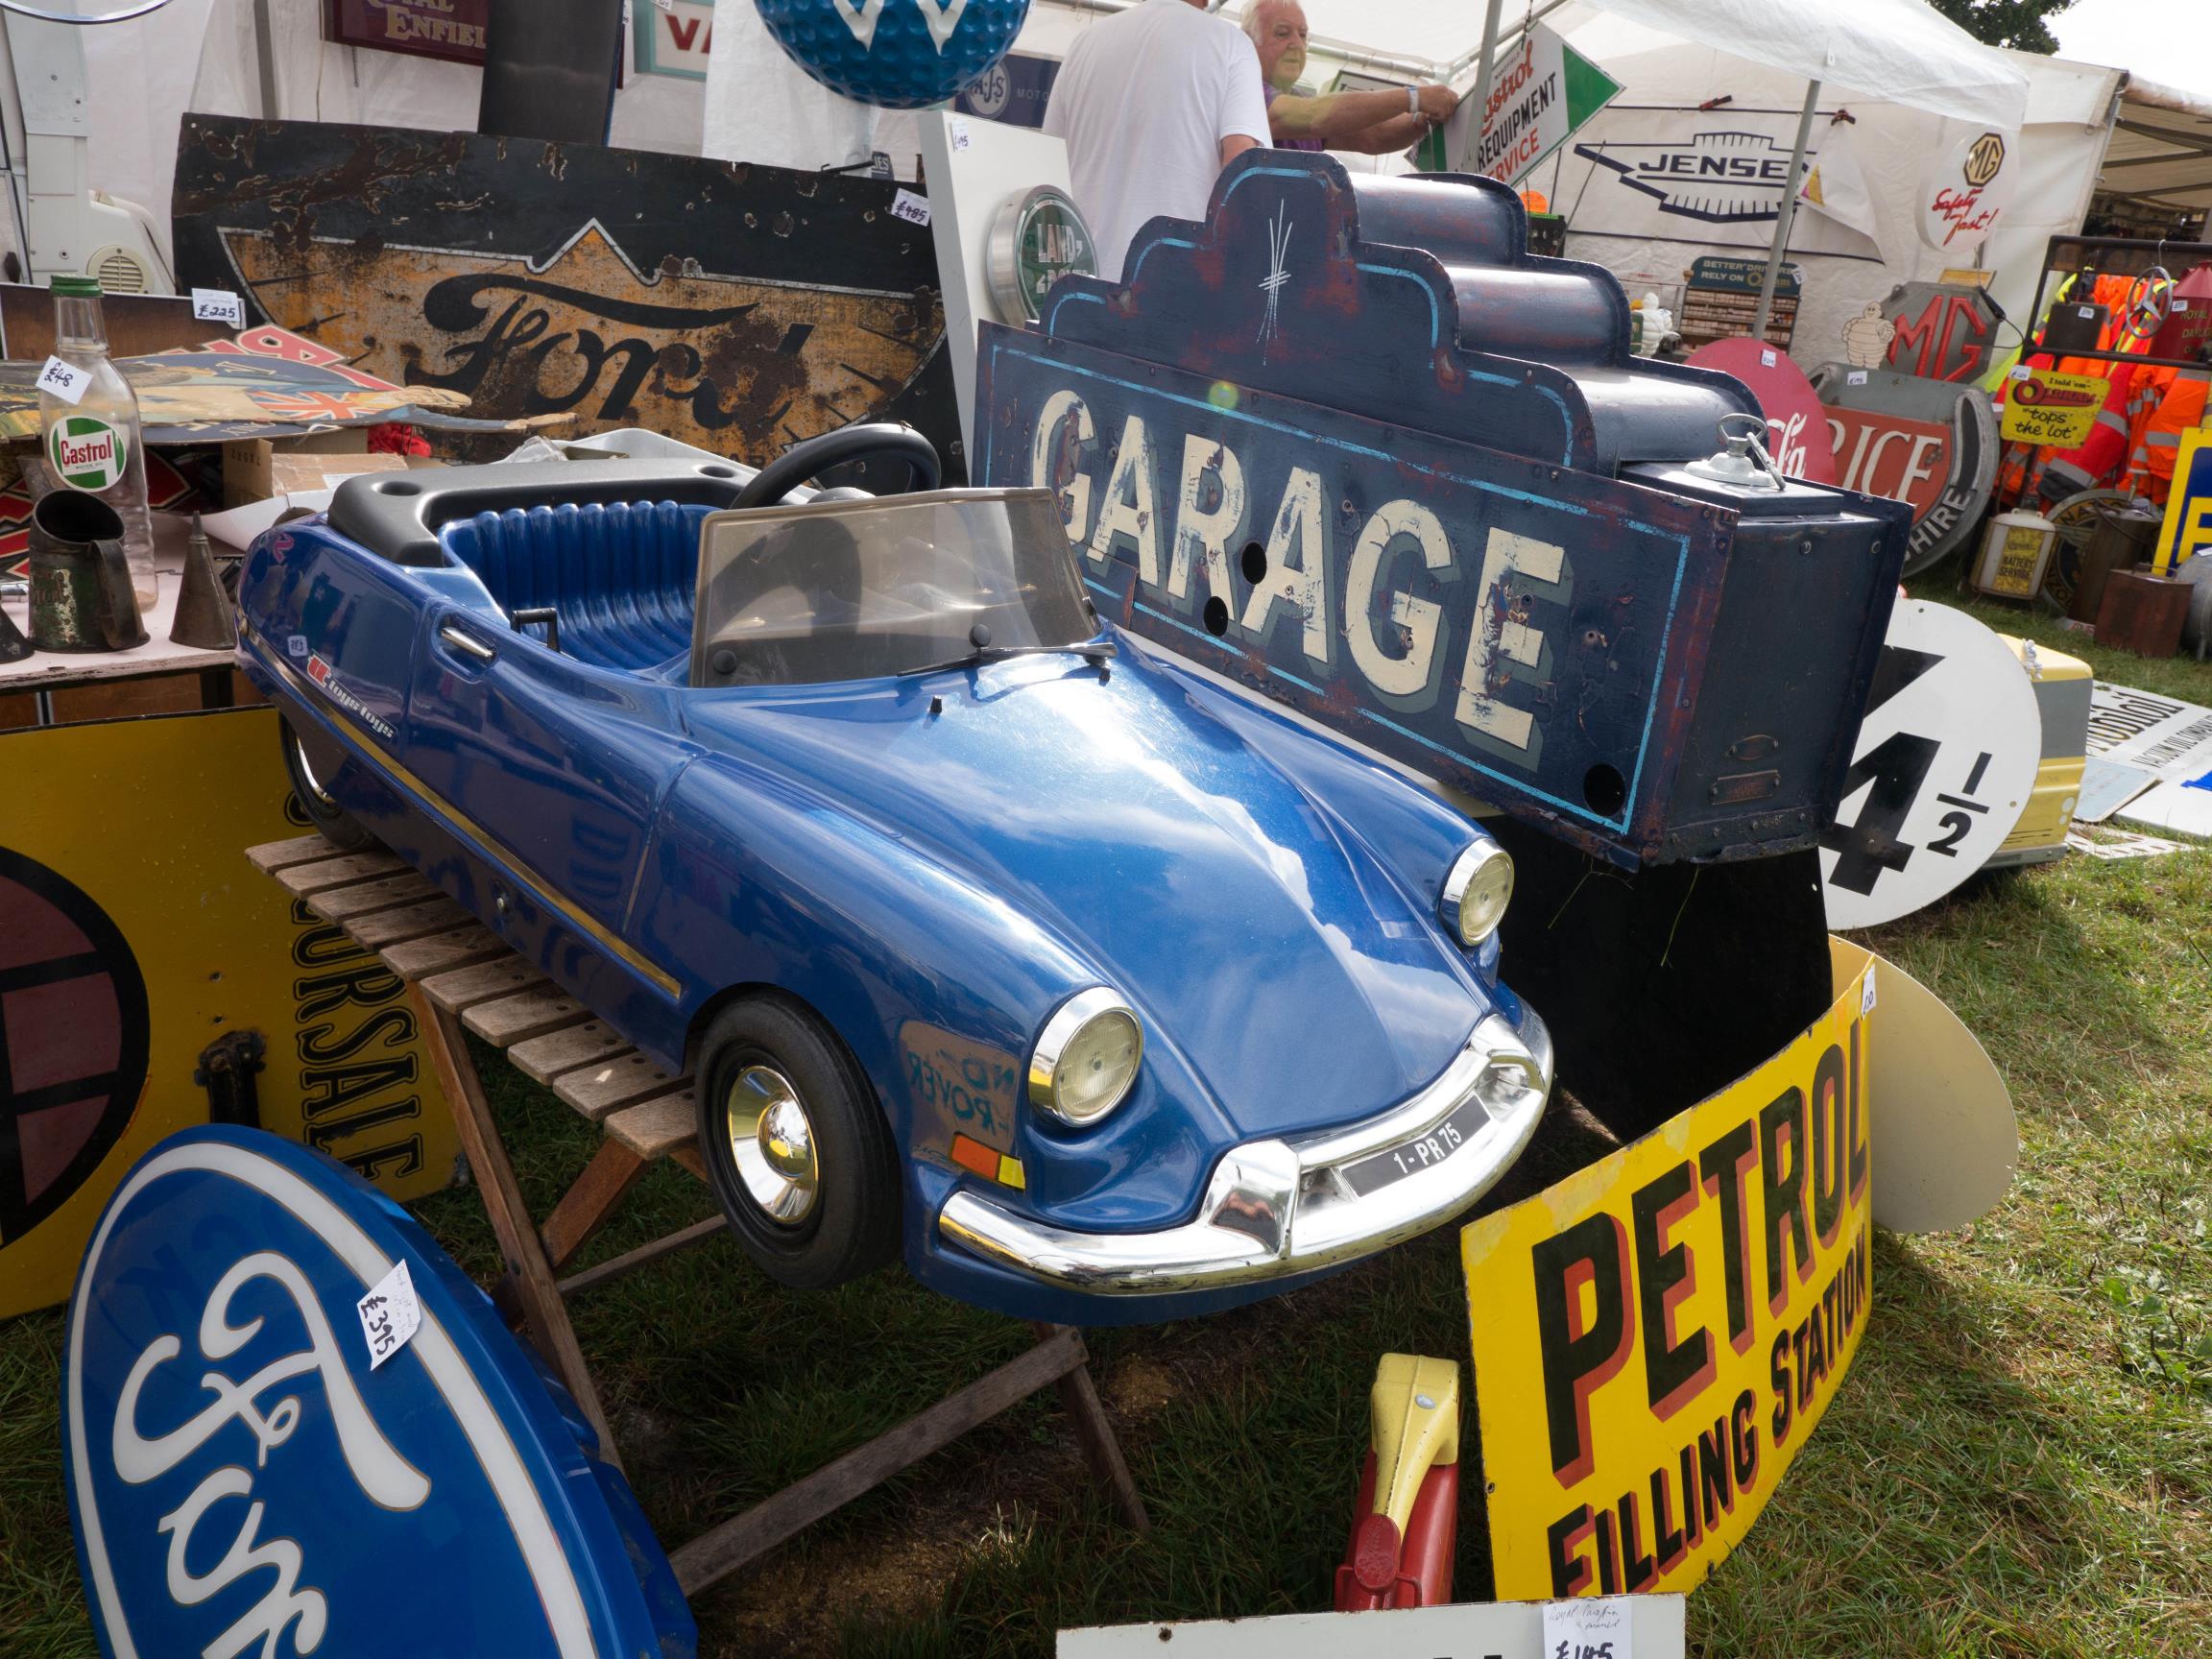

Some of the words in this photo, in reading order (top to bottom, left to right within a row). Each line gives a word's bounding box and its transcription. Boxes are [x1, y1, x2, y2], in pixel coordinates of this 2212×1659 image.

[384, 4, 487, 49] ENFIEL
[1016, 87, 1049, 102] MOTO
[1638, 154, 1791, 180] JENSE
[1700, 270, 1728, 280] RELY
[1728, 274, 1744, 282] ON
[197, 303, 236, 318] £225
[1887, 294, 1987, 382] MG
[60, 434, 113, 468] Castrol
[2014, 421, 2043, 436] the
[1904, 484, 1972, 562] HIRE
[1031, 388, 1568, 753] GARAGE
[1532, 1018, 1868, 1489] PETROL
[360, 1295, 397, 1356] £395
[1547, 1388, 1757, 1599] FILLING
[1770, 1226, 1868, 1448] STATION
[113, 1251, 432, 1659] For
